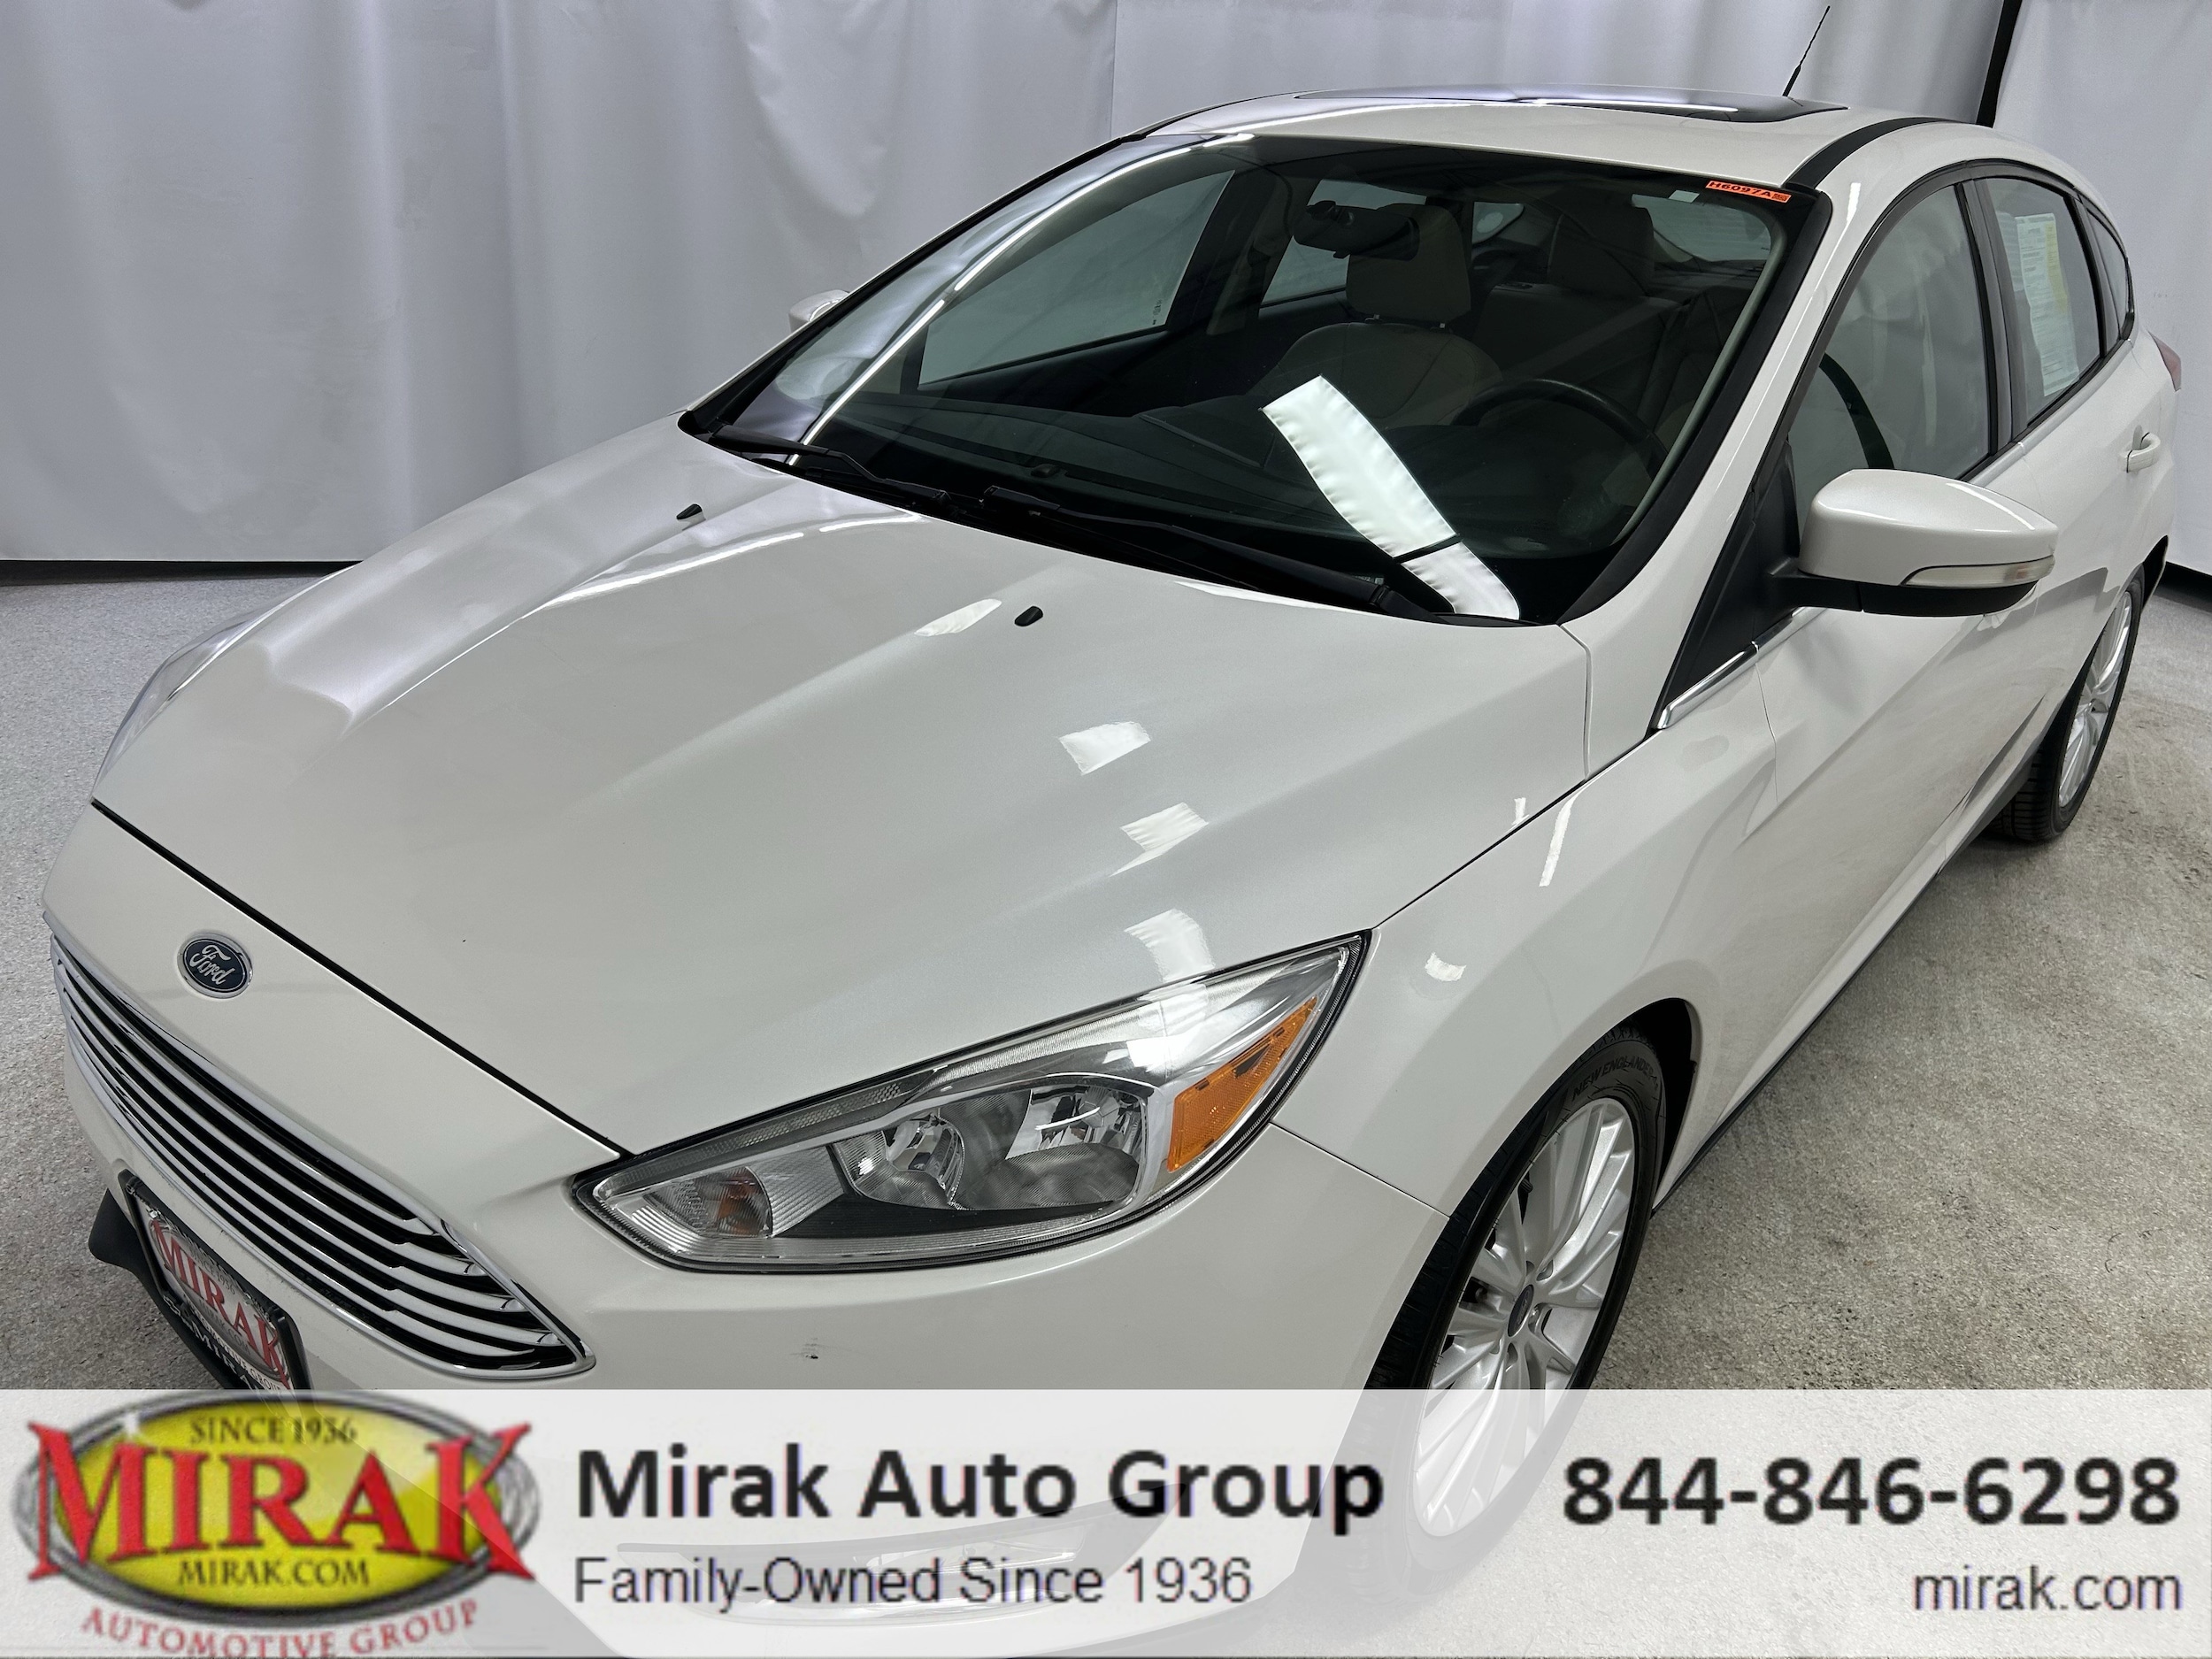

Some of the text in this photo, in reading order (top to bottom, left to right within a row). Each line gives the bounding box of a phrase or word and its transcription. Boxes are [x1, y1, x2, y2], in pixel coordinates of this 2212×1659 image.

[1708, 181, 1771, 197] H6097A
[189, 944, 236, 985] Ford
[1571, 1066, 1601, 1102] NEW
[150, 1218, 292, 1391] MIRAK
